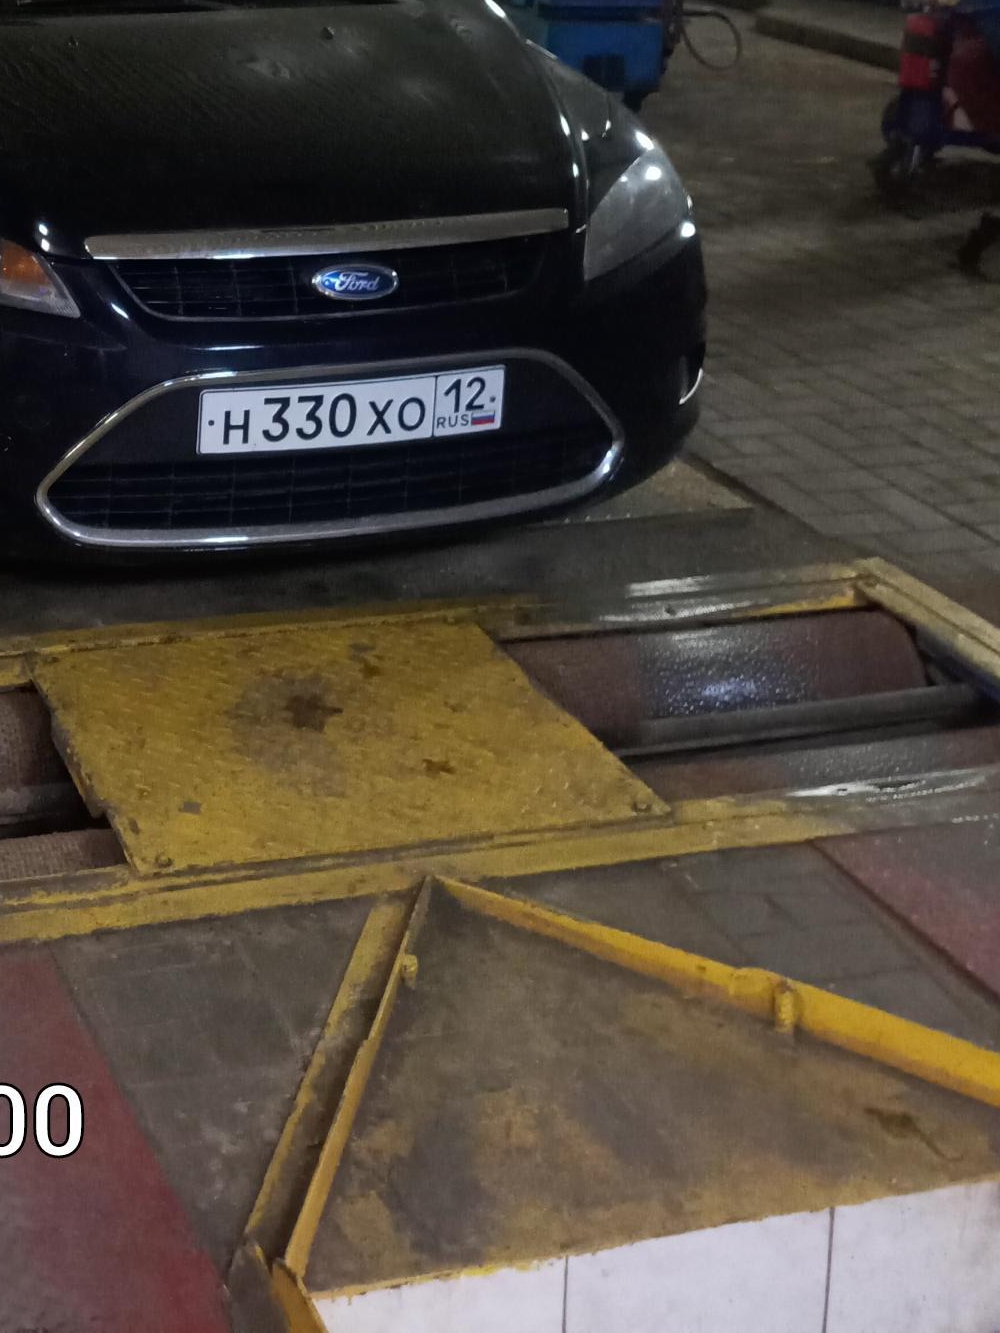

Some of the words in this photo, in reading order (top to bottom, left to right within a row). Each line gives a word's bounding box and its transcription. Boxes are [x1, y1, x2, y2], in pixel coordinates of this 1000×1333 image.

[322, 271, 381, 292] Ford
[444, 376, 486, 414] 12
[436, 413, 470, 430] RUS
